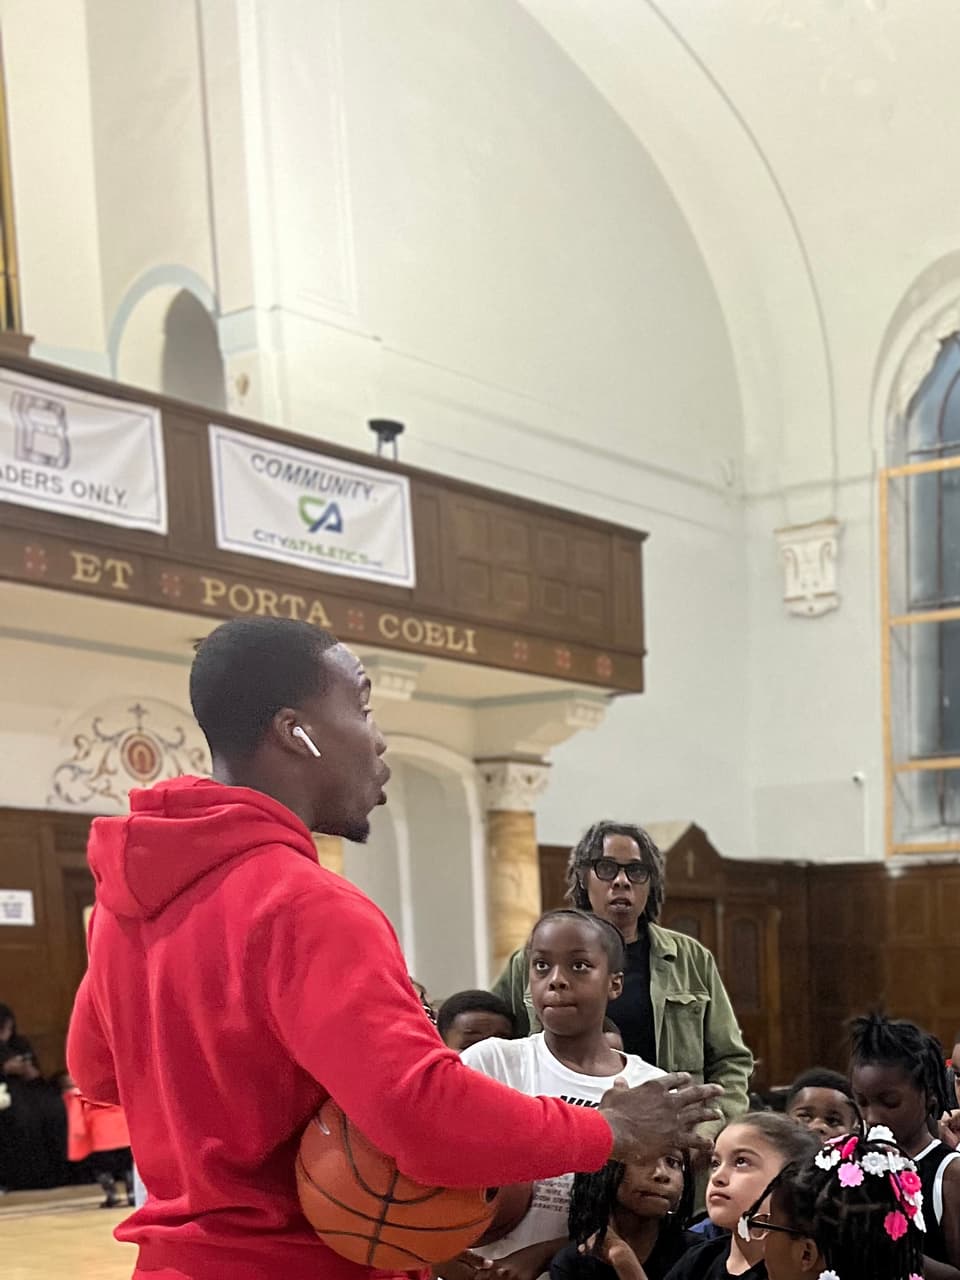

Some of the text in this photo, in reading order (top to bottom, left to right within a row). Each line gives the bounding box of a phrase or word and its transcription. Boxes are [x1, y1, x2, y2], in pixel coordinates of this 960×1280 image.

[0, 464, 64, 495] DERS
[70, 551, 478, 655] ET PORTA COELI
